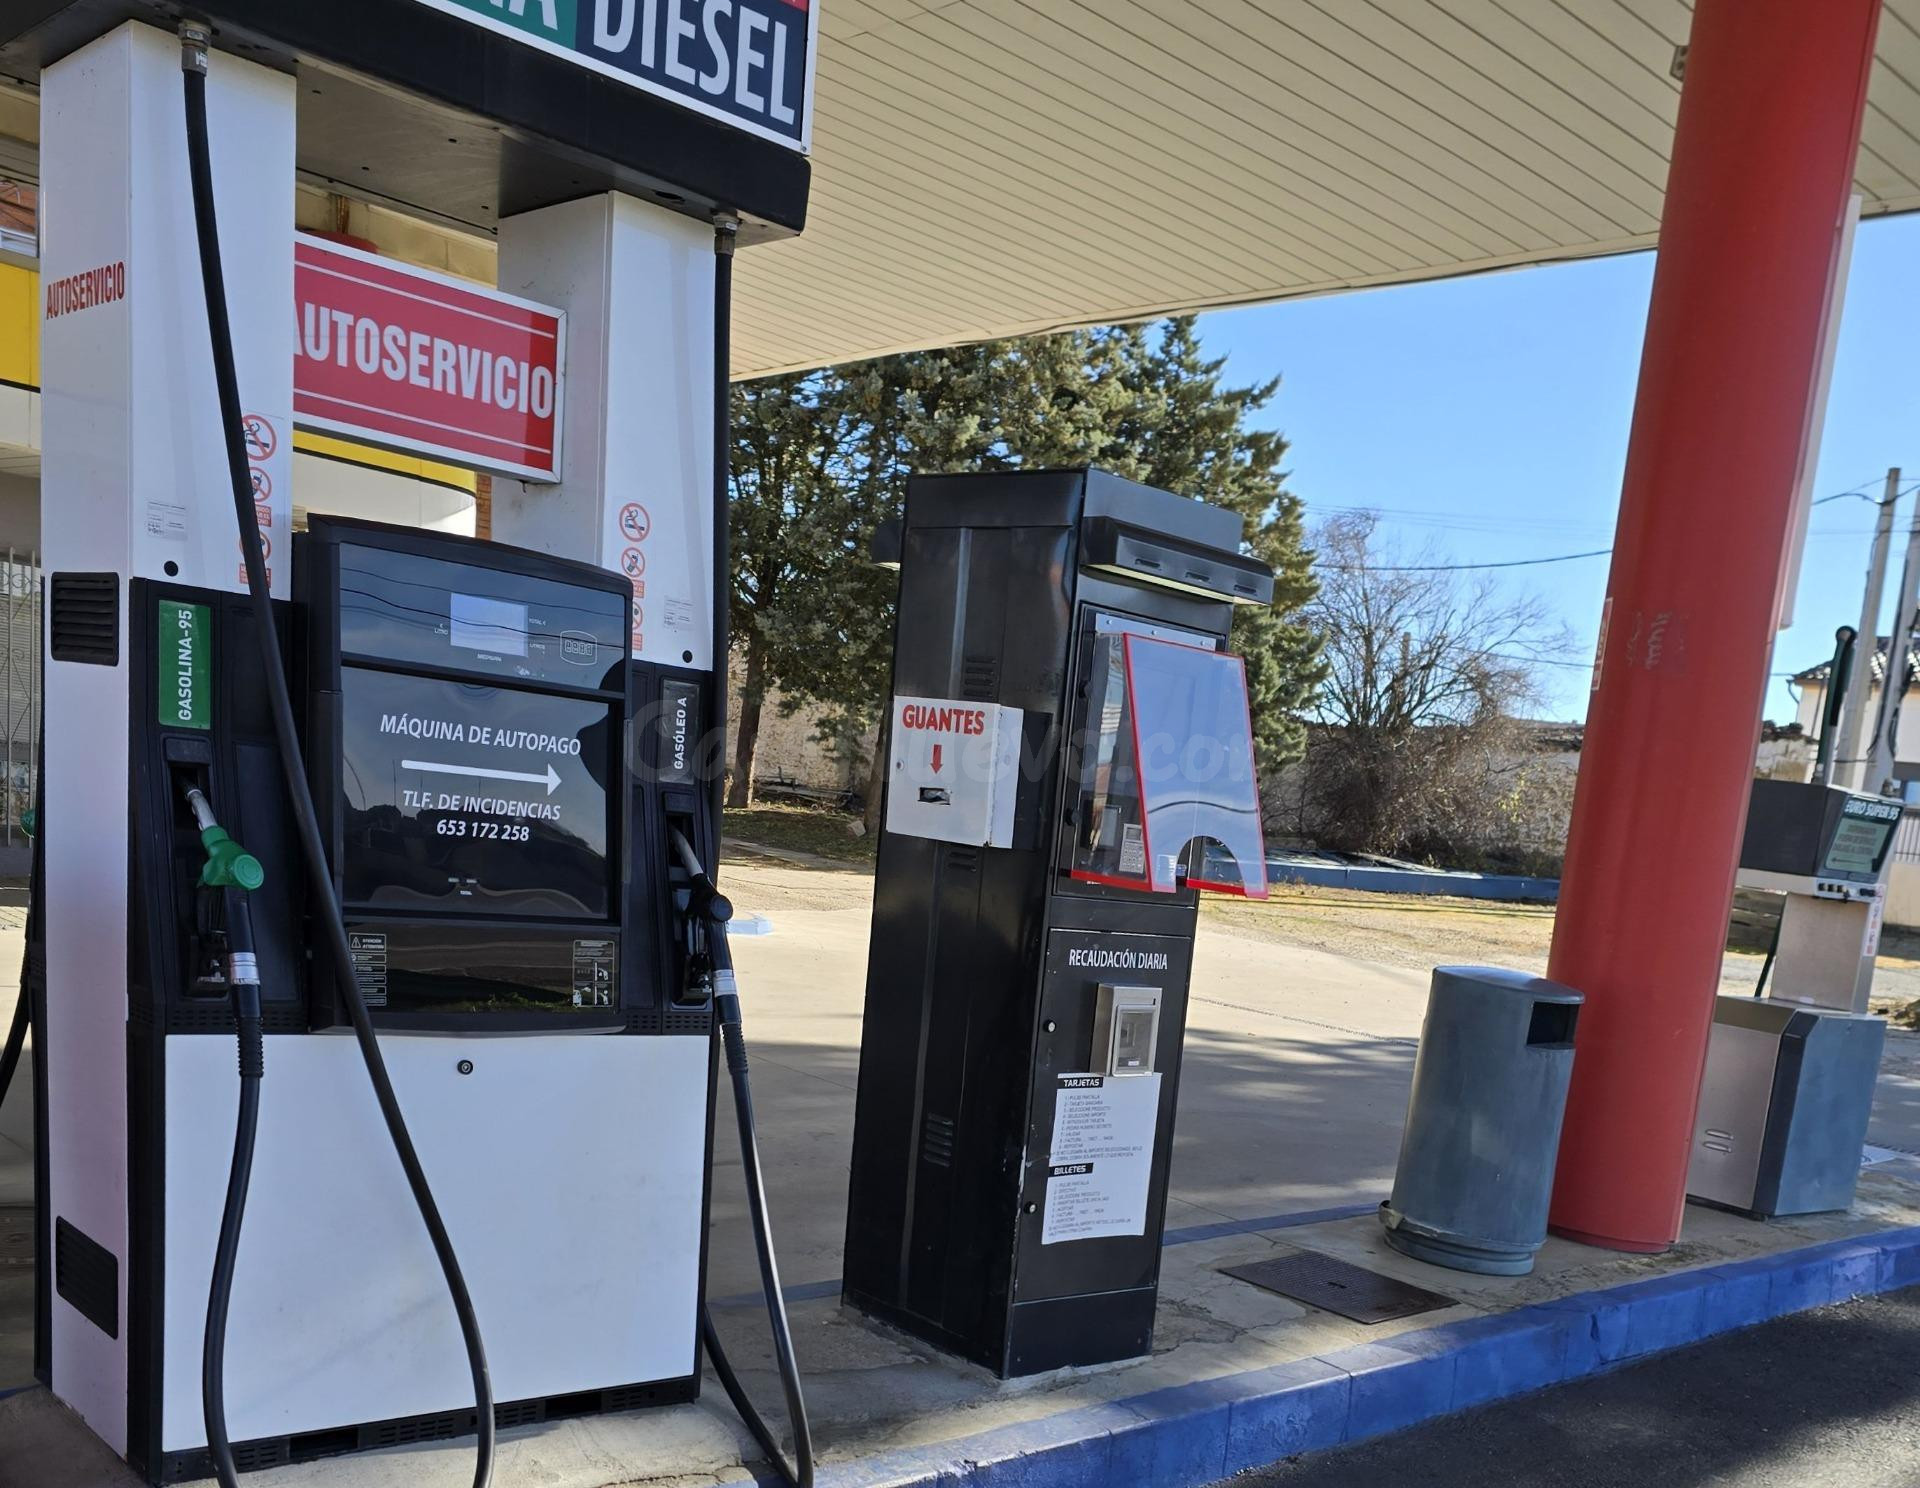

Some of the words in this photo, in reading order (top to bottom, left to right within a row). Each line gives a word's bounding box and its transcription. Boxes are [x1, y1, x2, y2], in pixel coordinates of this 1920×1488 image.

[594, 0, 795, 125] DIESEL
[46, 261, 125, 320] AUTOSERVICIO
[178, 609, 192, 720] GASOLINA-95
[677, 697, 687, 707] A
[380, 713, 464, 742] MÁQUINA
[468, 725, 491, 745] DE
[493, 729, 581, 756] AUTOPAGO
[902, 704, 985, 735] GUANTES
[673, 709, 686, 770] GASÓLEO
[403, 790, 433, 808] TLF.
[438, 793, 460, 811] DE
[463, 796, 561, 820] INCIDENCIAS
[1844, 800, 1866, 814] EURO
[1865, 804, 1889, 819] SUPER
[1888, 807, 1900, 820] 95
[437, 819, 466, 837] 653
[472, 822, 498, 839] 172
[501, 825, 530, 841] 258
[1069, 948, 1136, 969] RECAUDACIÓN
[1138, 952, 1168, 970] DIARIA
[1063, 1078, 1100, 1088] TARJETAS
[1054, 1165, 1087, 1175] BILLETES
